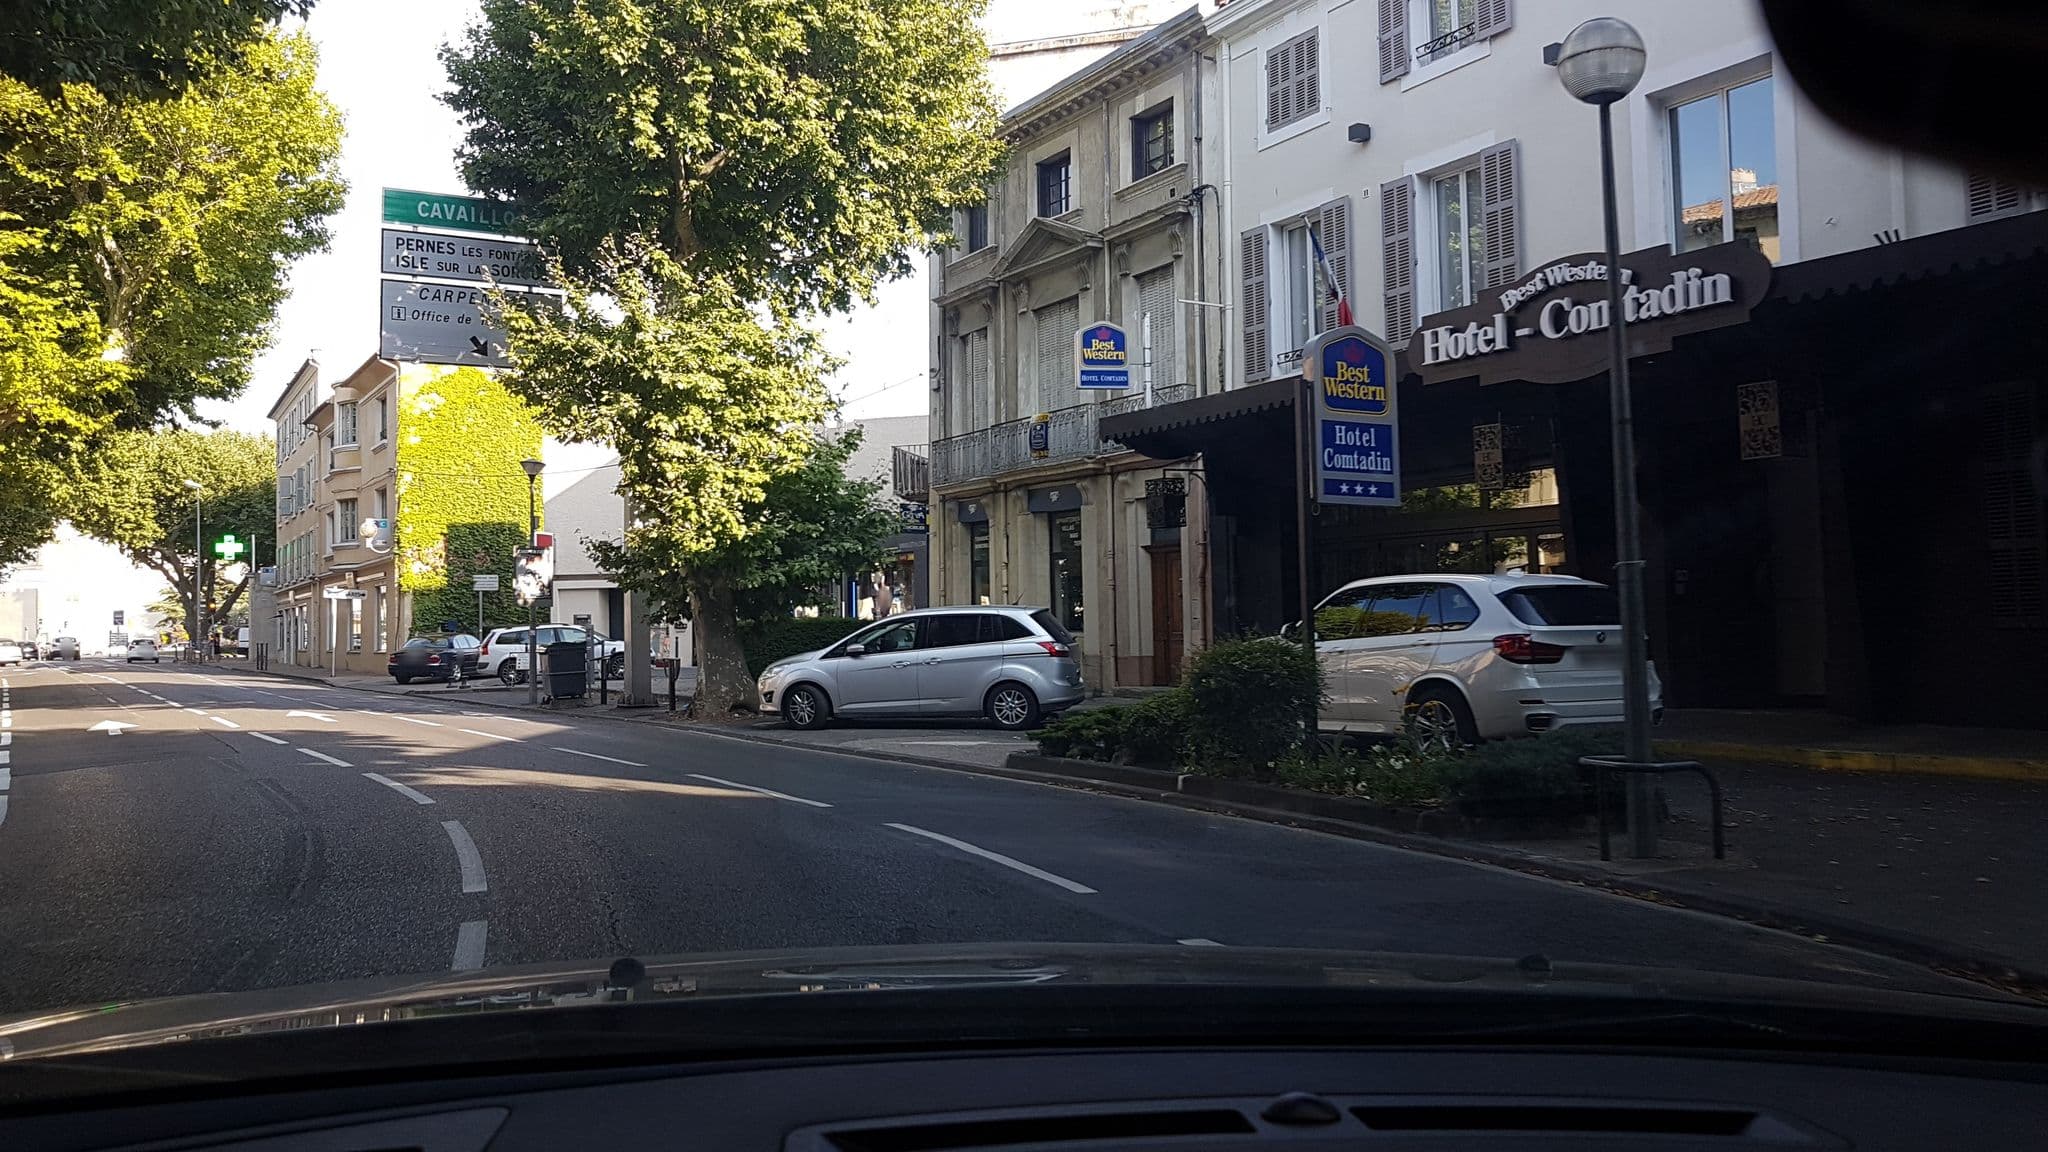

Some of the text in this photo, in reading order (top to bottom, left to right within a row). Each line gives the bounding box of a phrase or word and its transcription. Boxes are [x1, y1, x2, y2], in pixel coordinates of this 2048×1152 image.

[396, 237, 456, 255] PERNES
[462, 246, 482, 258] LES
[396, 254, 428, 270] ISLE
[437, 261, 460, 273] SUR
[468, 264, 482, 275] LA
[1498, 260, 1633, 312] Best Westen
[412, 310, 450, 323] Office
[457, 314, 472, 325] de
[1091, 339, 1115, 350] Best
[1420, 313, 1509, 366] Hotel
[1083, 348, 1125, 360] Western
[1336, 360, 1370, 383] Best
[1323, 376, 1386, 401] Western
[1334, 425, 1376, 447] Hotel
[1323, 447, 1391, 471] Comtadin
